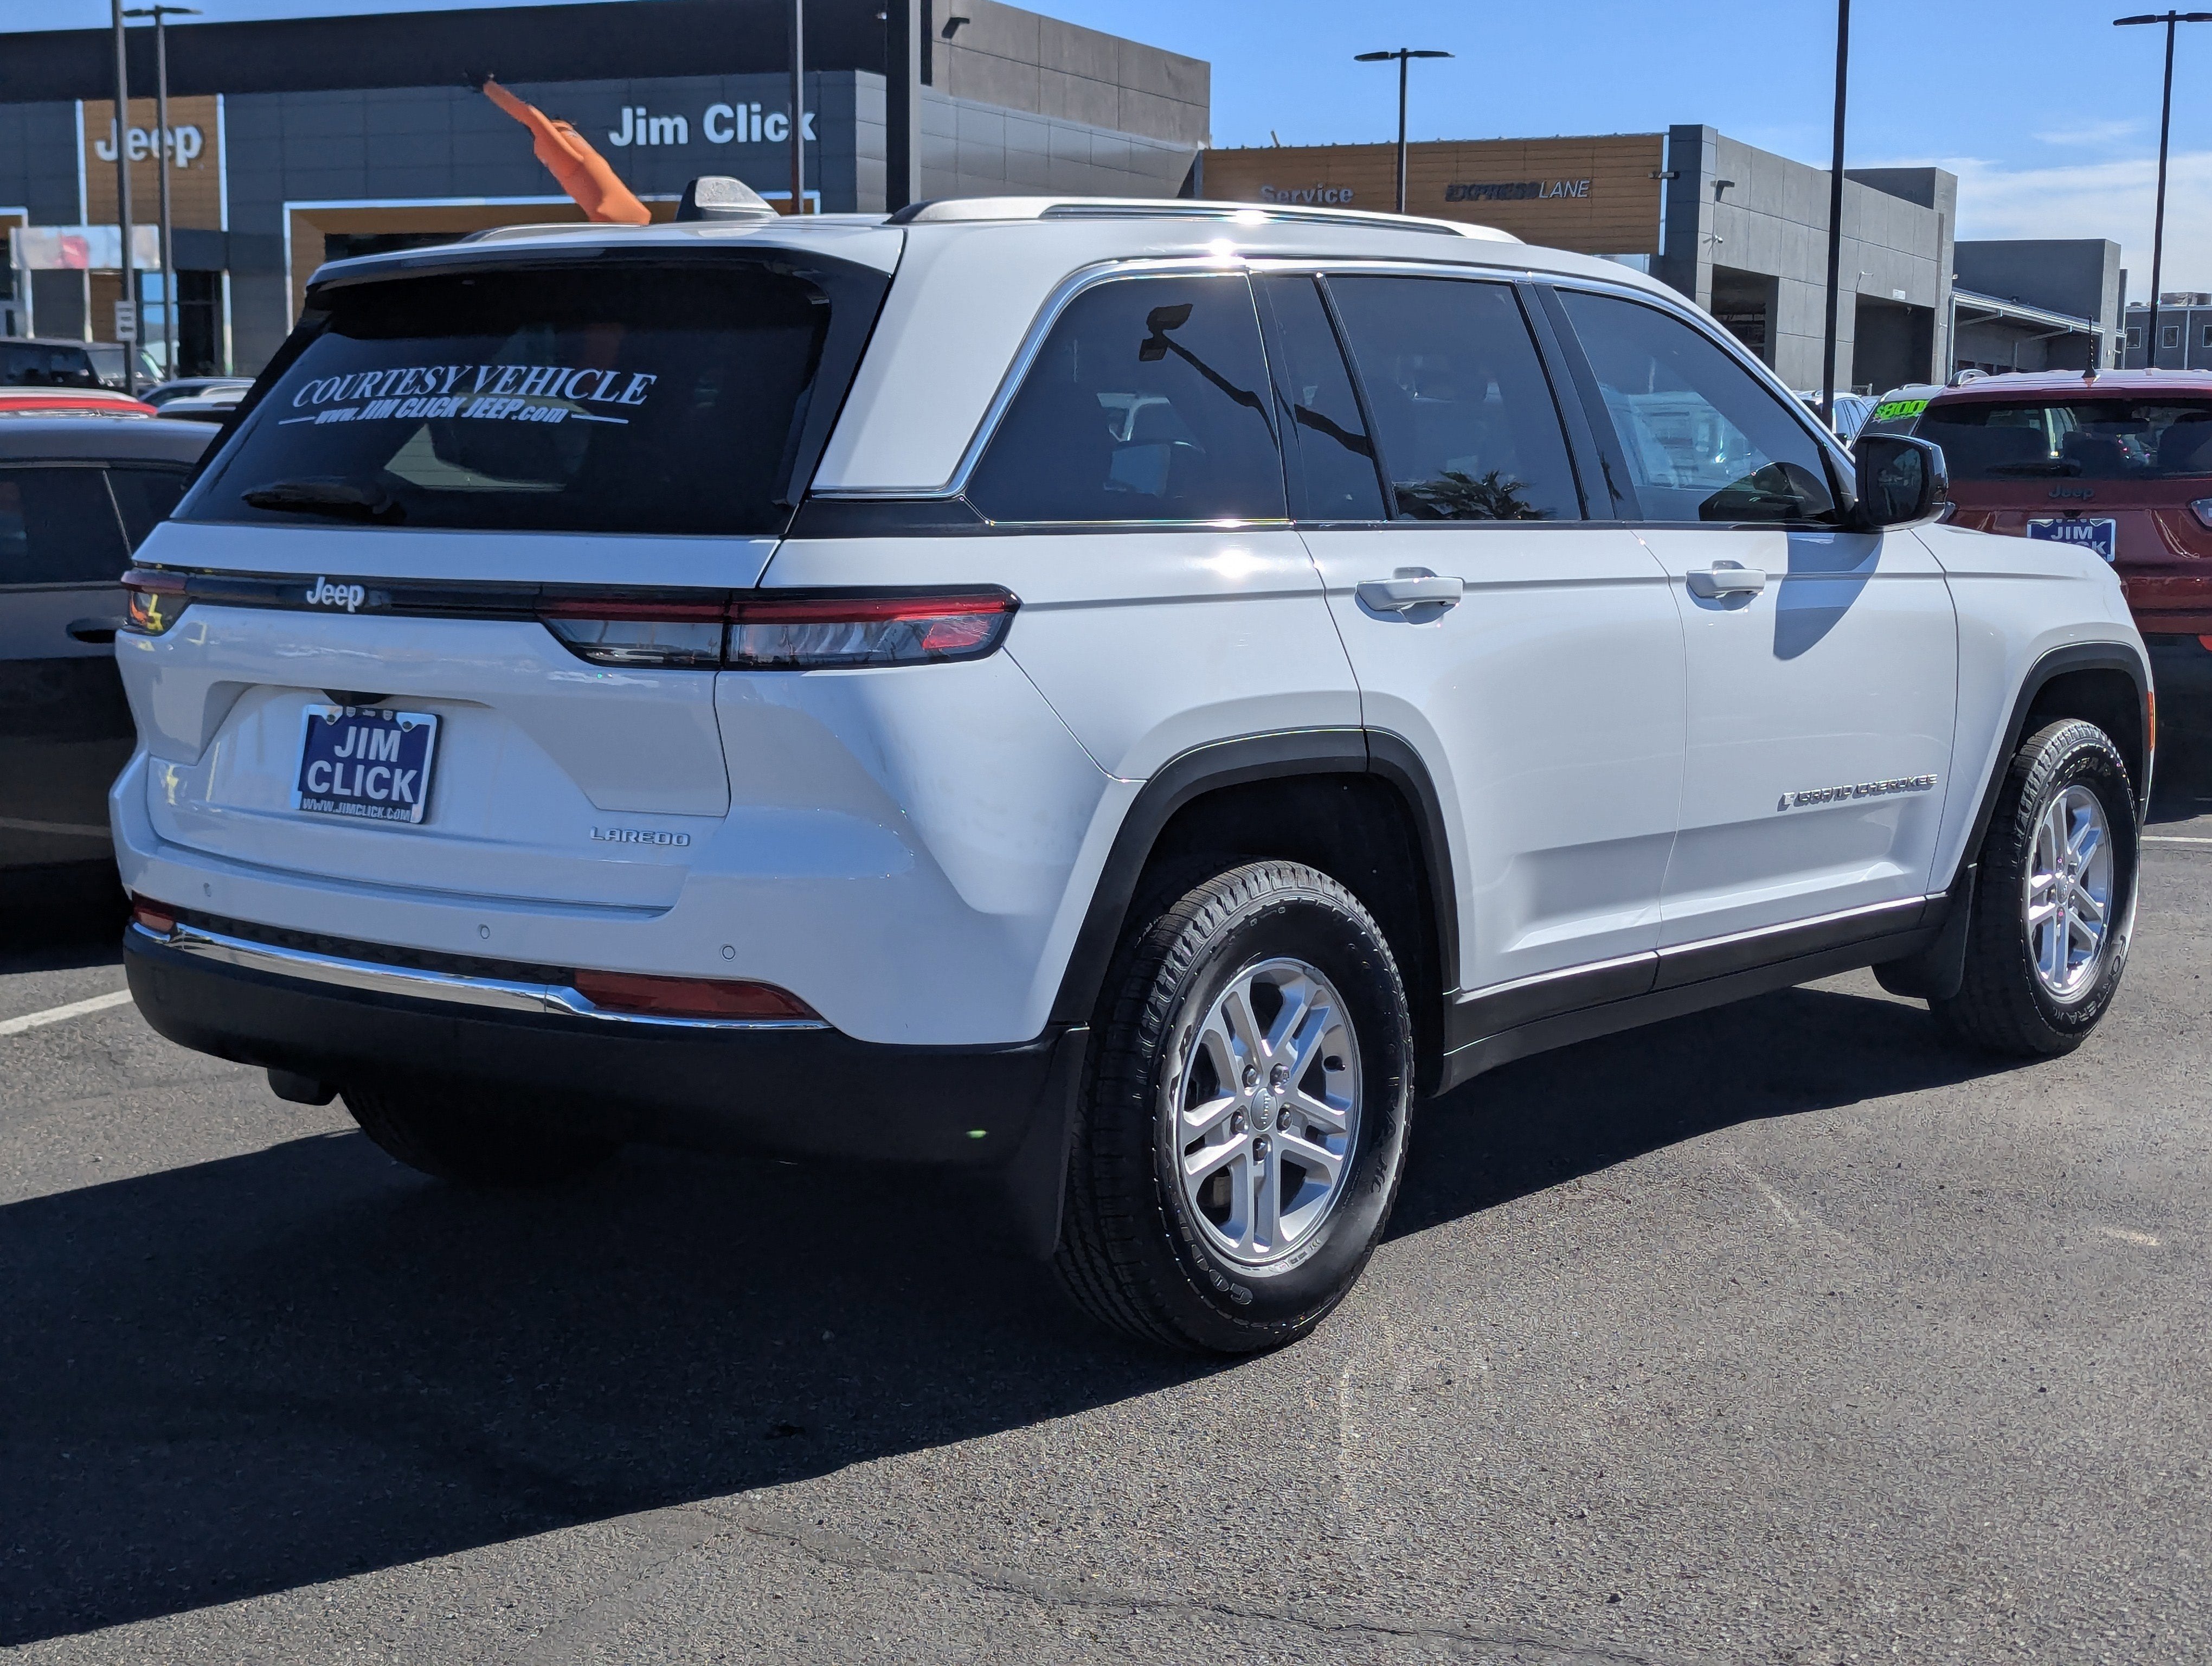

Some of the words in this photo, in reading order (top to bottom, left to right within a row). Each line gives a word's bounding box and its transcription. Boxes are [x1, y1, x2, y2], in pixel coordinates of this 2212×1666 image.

[608, 106, 689, 147] Jim
[703, 102, 816, 144] Click
[94, 118, 203, 168] Jeep
[1260, 183, 1354, 204] Service
[1539, 180, 1590, 198] LANE
[293, 366, 474, 408] COURTESY
[475, 364, 658, 406] VEHICLE
[2048, 486, 2095, 500] Jeep
[2050, 526, 2093, 540] JIM
[306, 576, 365, 613] Jeep
[334, 726, 402, 762] JIM
[307, 760, 417, 803] CLICK
[1856, 773, 1938, 794] CHEROKEE
[303, 797, 411, 822] WWW.JIMCLICK.COM
[589, 826, 691, 847] LAREDO
